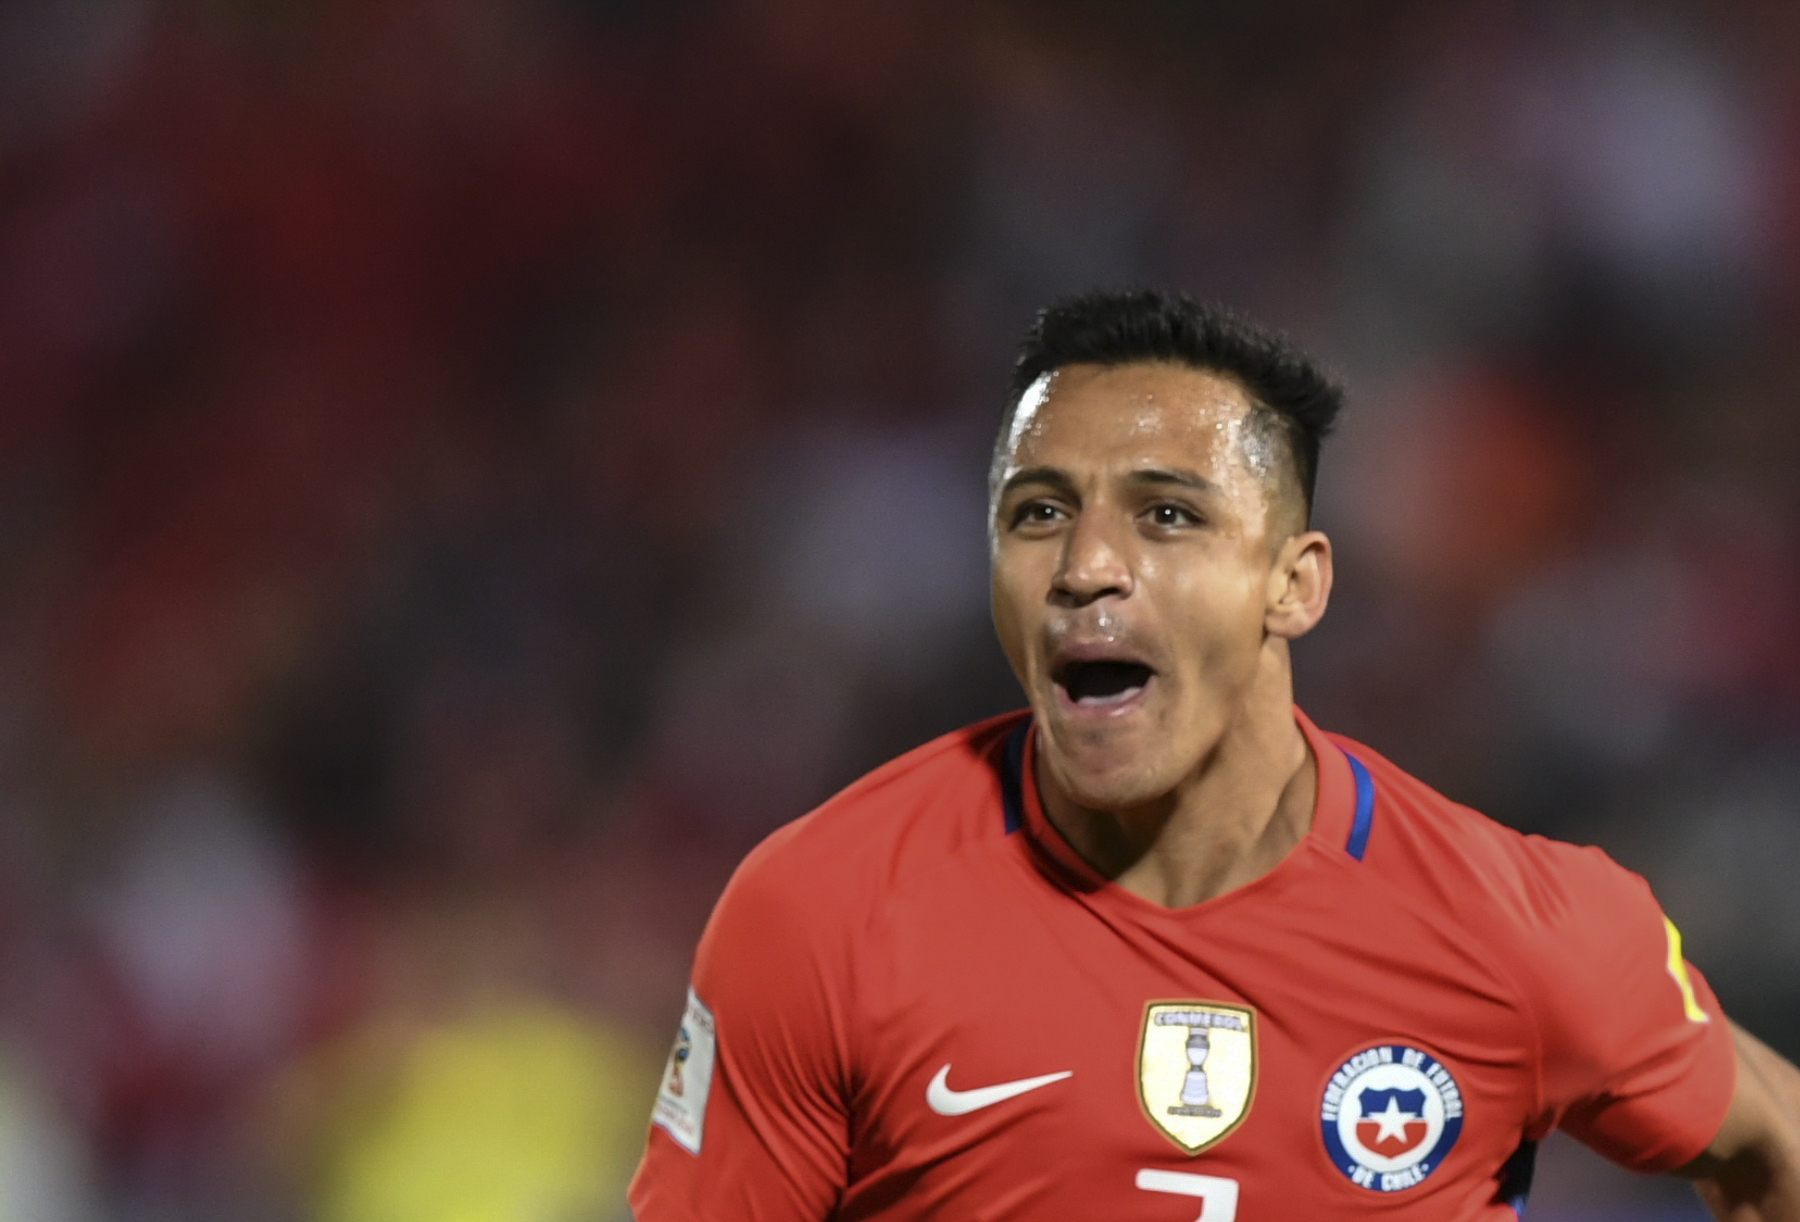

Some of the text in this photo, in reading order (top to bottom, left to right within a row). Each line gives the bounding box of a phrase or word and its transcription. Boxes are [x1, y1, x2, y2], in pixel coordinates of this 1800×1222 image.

[1154, 1011, 1242, 1032] CONMEBOL
[1402, 1048, 1426, 1069] DE
[1351, 1163, 1427, 1192] DE CHILE
